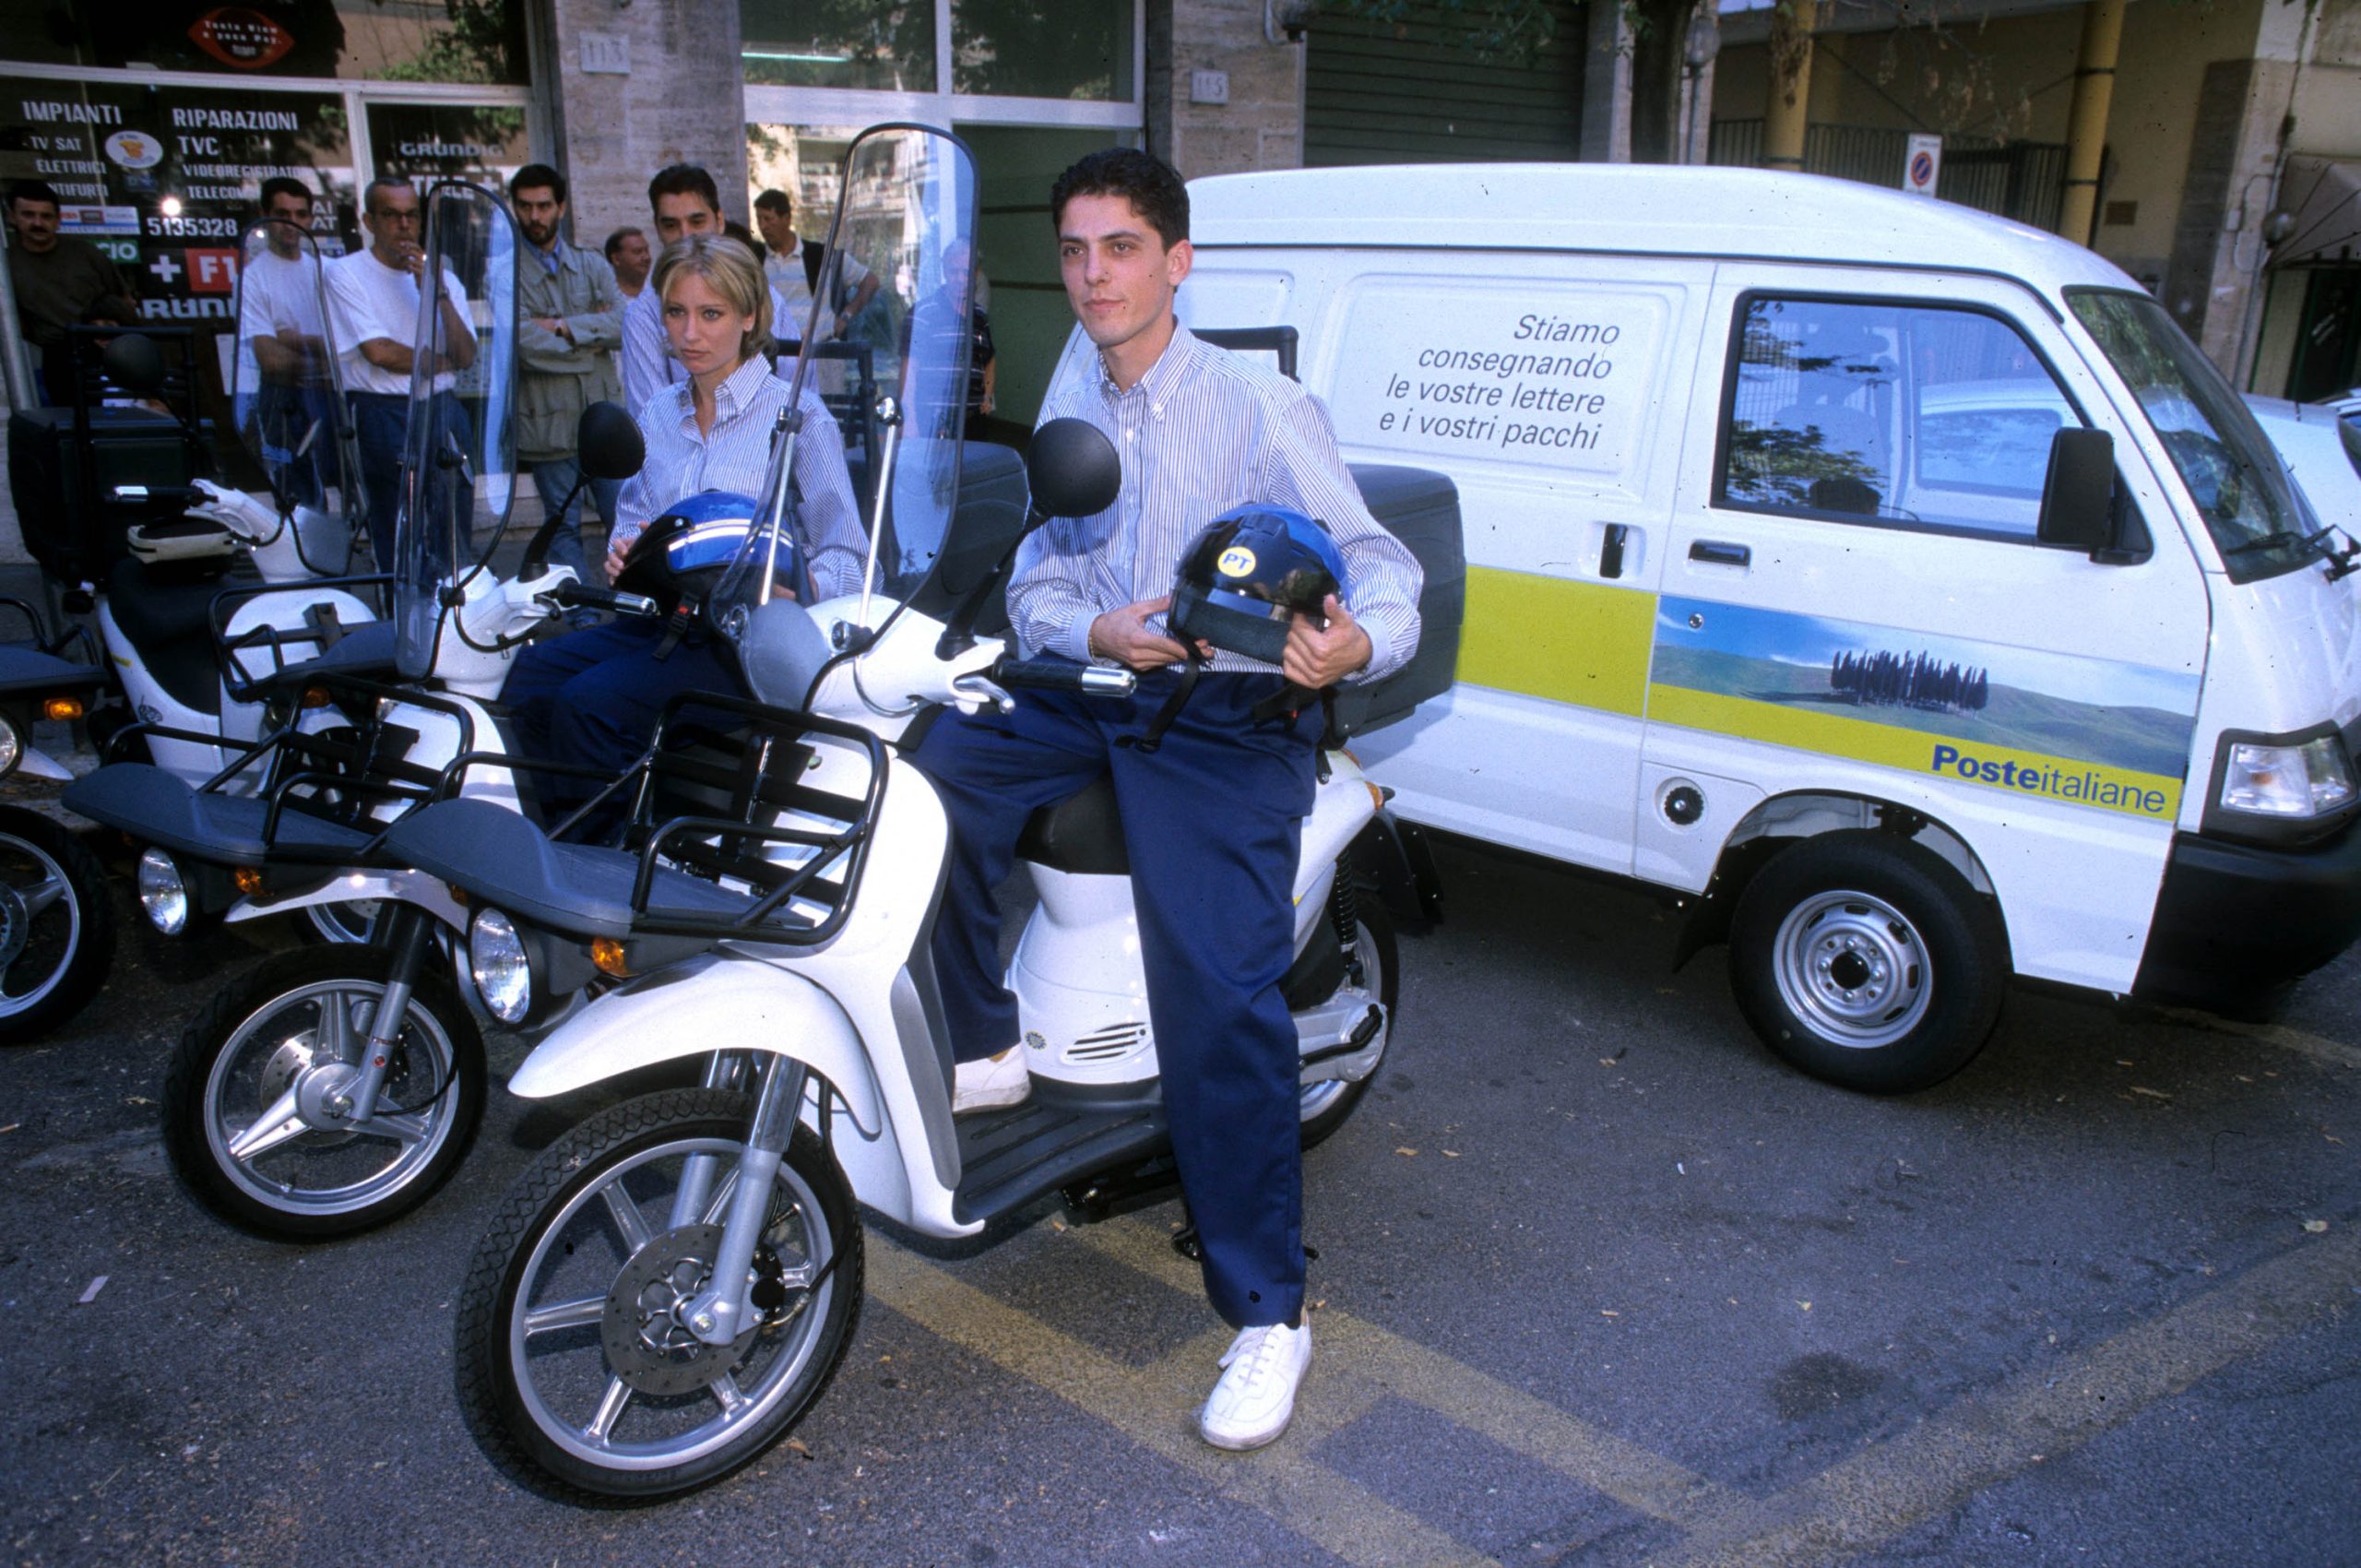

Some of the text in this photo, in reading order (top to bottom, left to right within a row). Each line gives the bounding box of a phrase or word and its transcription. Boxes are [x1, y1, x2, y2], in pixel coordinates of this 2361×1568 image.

[22, 101, 122, 125] IMPIANTI
[172, 108, 298, 131] RIPARAZIONI
[30, 136, 81, 151] TV SAT
[177, 136, 219, 156] TVC
[35, 159, 107, 174] ELETTRICI
[47, 183, 109, 197] NTIFURTI
[147, 217, 238, 237] 5135328
[198, 255, 238, 283] F1
[1513, 314, 1620, 345] Stiamo
[1418, 348, 1612, 380] consegnando
[1386, 373, 1605, 415] le vostre lettere
[1379, 408, 1603, 450] e i vostri pacchi
[1223, 552, 1252, 570] PT
